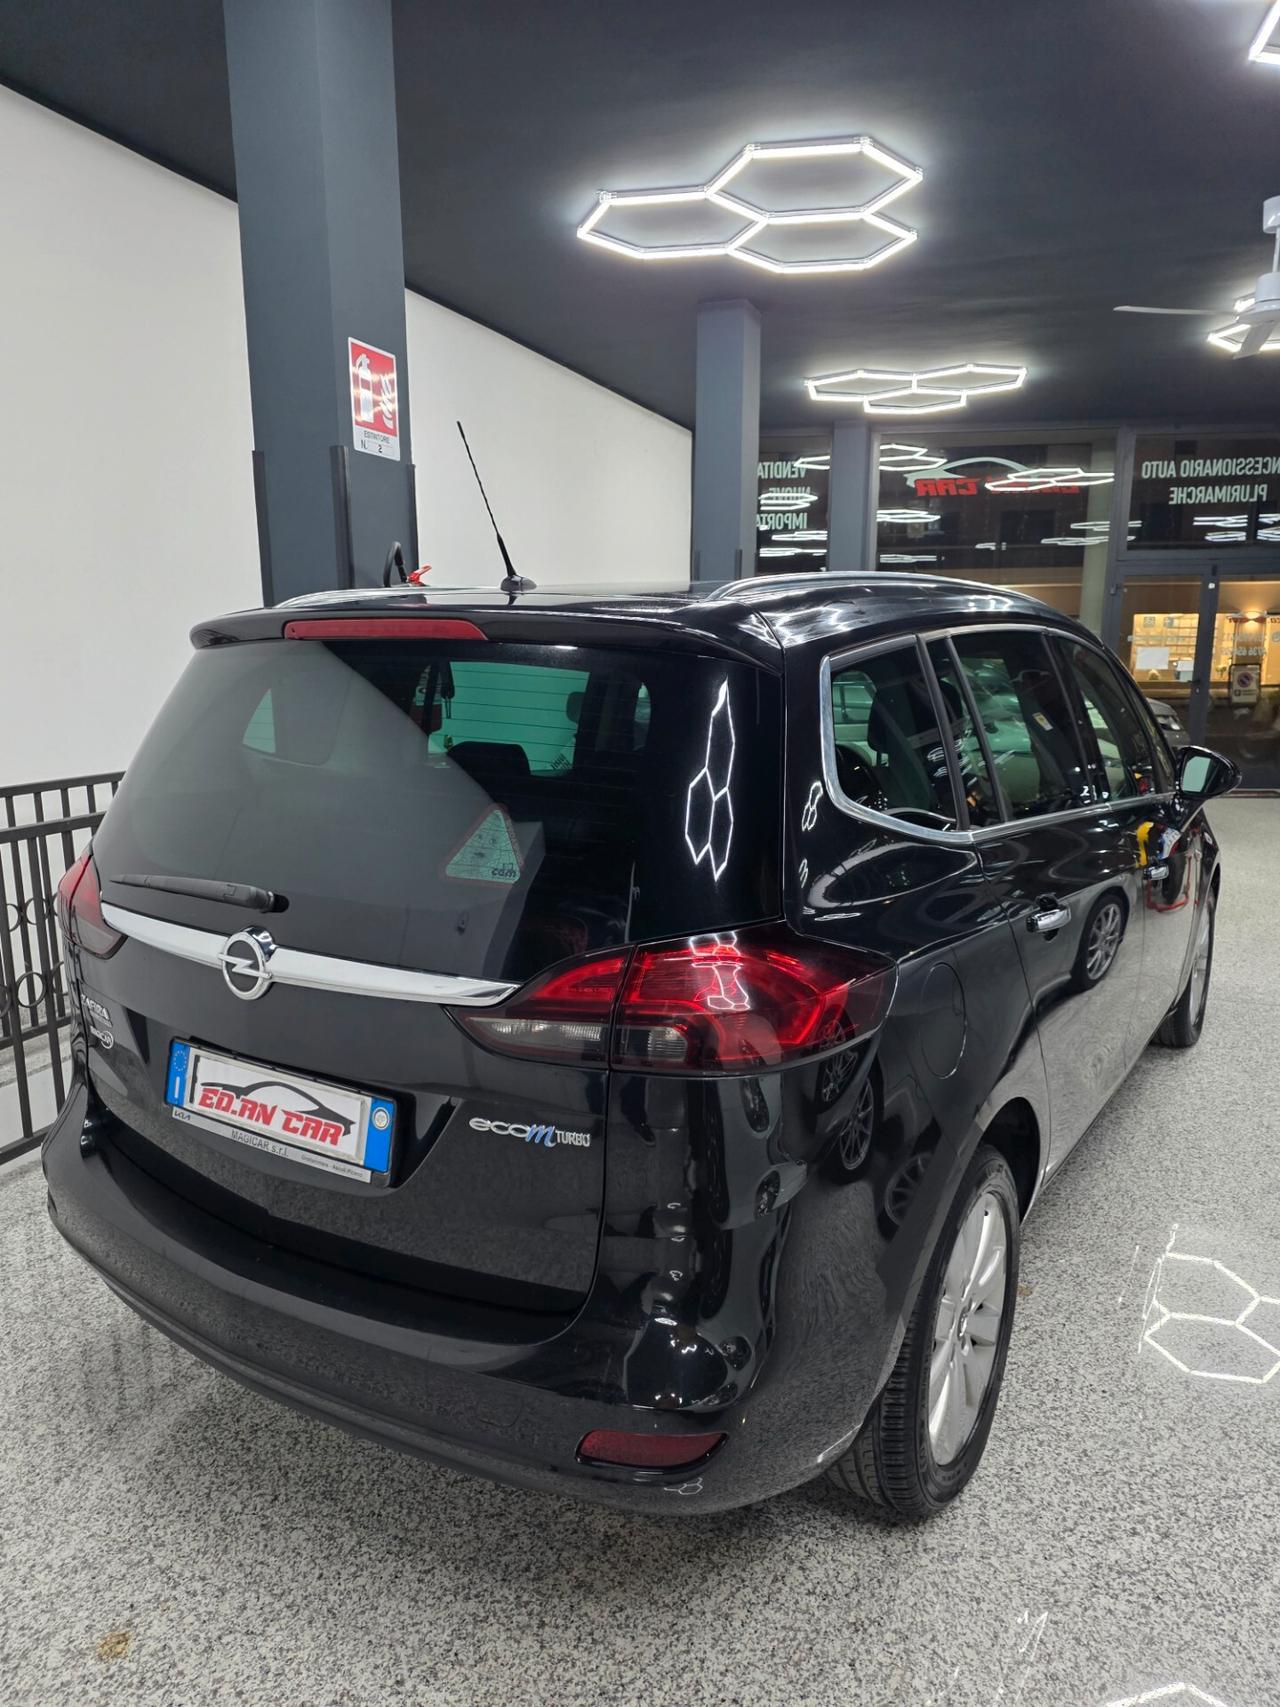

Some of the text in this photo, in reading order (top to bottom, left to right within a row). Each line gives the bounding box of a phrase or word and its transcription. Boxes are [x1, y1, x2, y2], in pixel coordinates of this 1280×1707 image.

[378, 444, 383, 453] 2
[198, 1087, 344, 1147] ED.AN CAR
[231, 1129, 270, 1151] MAGICAR
